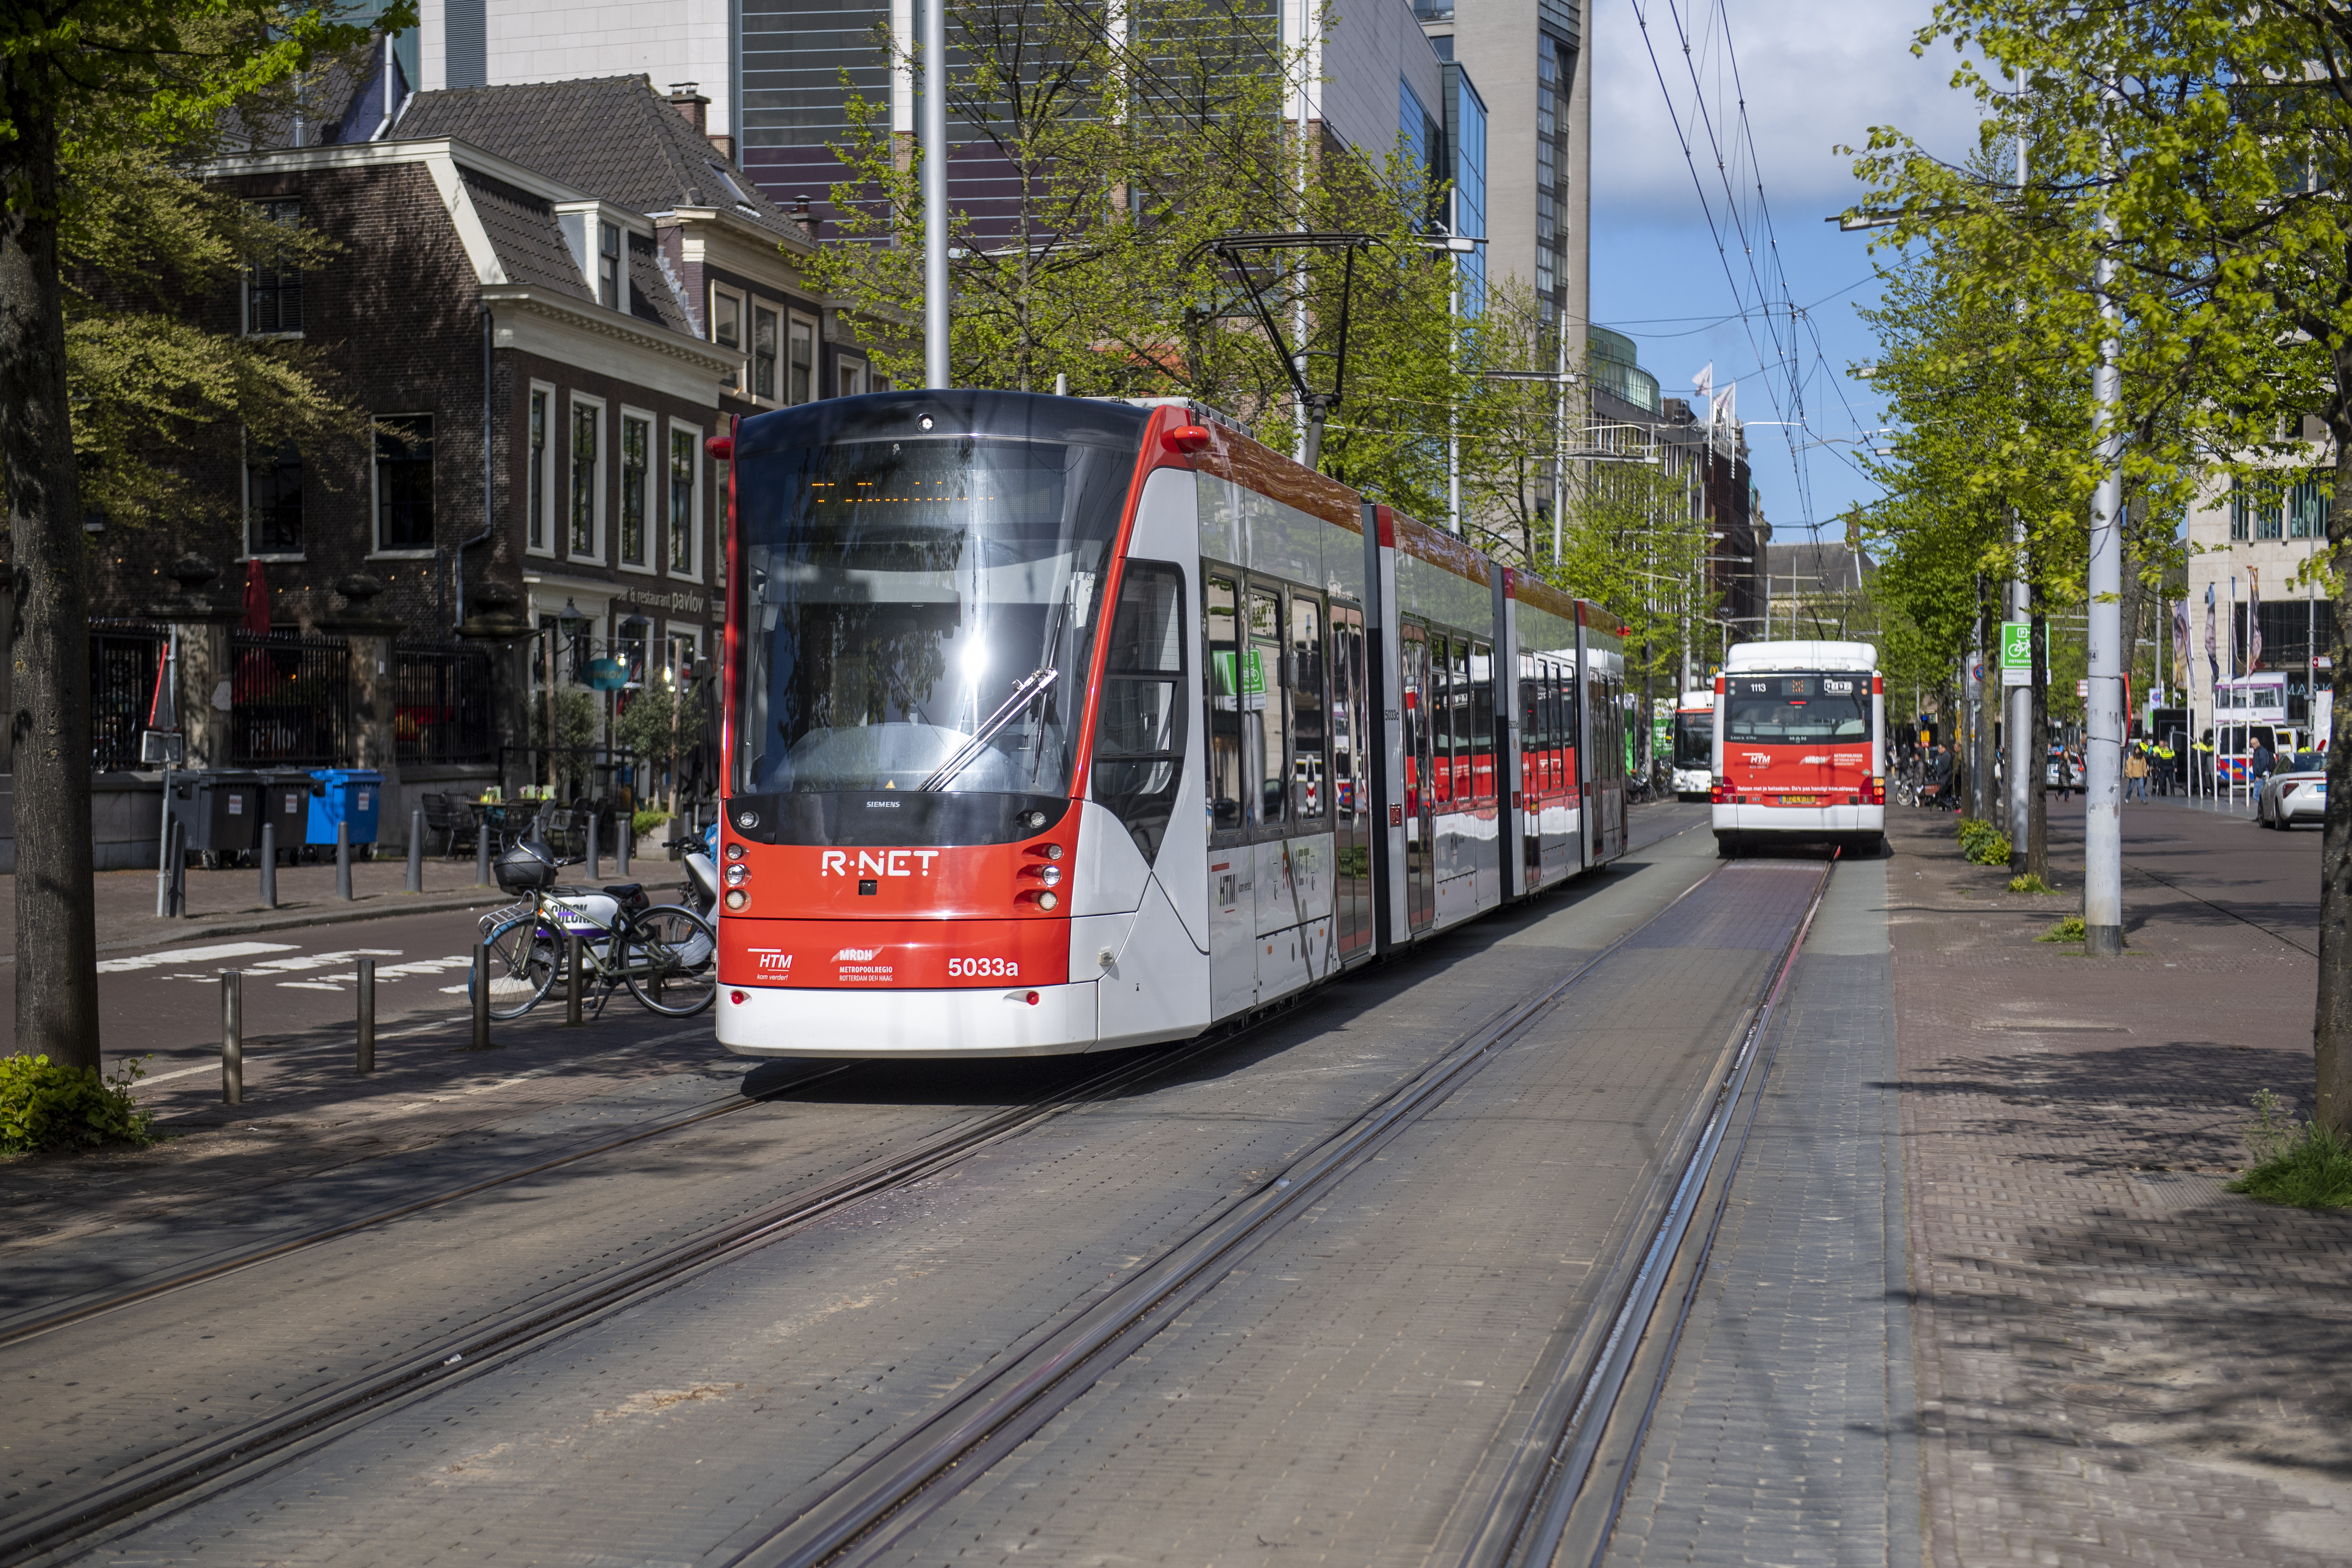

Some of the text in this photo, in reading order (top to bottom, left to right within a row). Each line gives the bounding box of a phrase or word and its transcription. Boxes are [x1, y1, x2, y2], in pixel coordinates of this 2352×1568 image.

[630, 587, 635, 602] &
[637, 590, 671, 608] restaurant
[672, 590, 704, 613] pavlov
[1751, 683, 1766, 692] 1113
[1385, 709, 1399, 721] 5033c
[1220, 873, 1235, 907] HTM
[759, 954, 793, 968] HTM
[839, 949, 873, 961] MRDH
[949, 957, 1019, 977] 5033a
